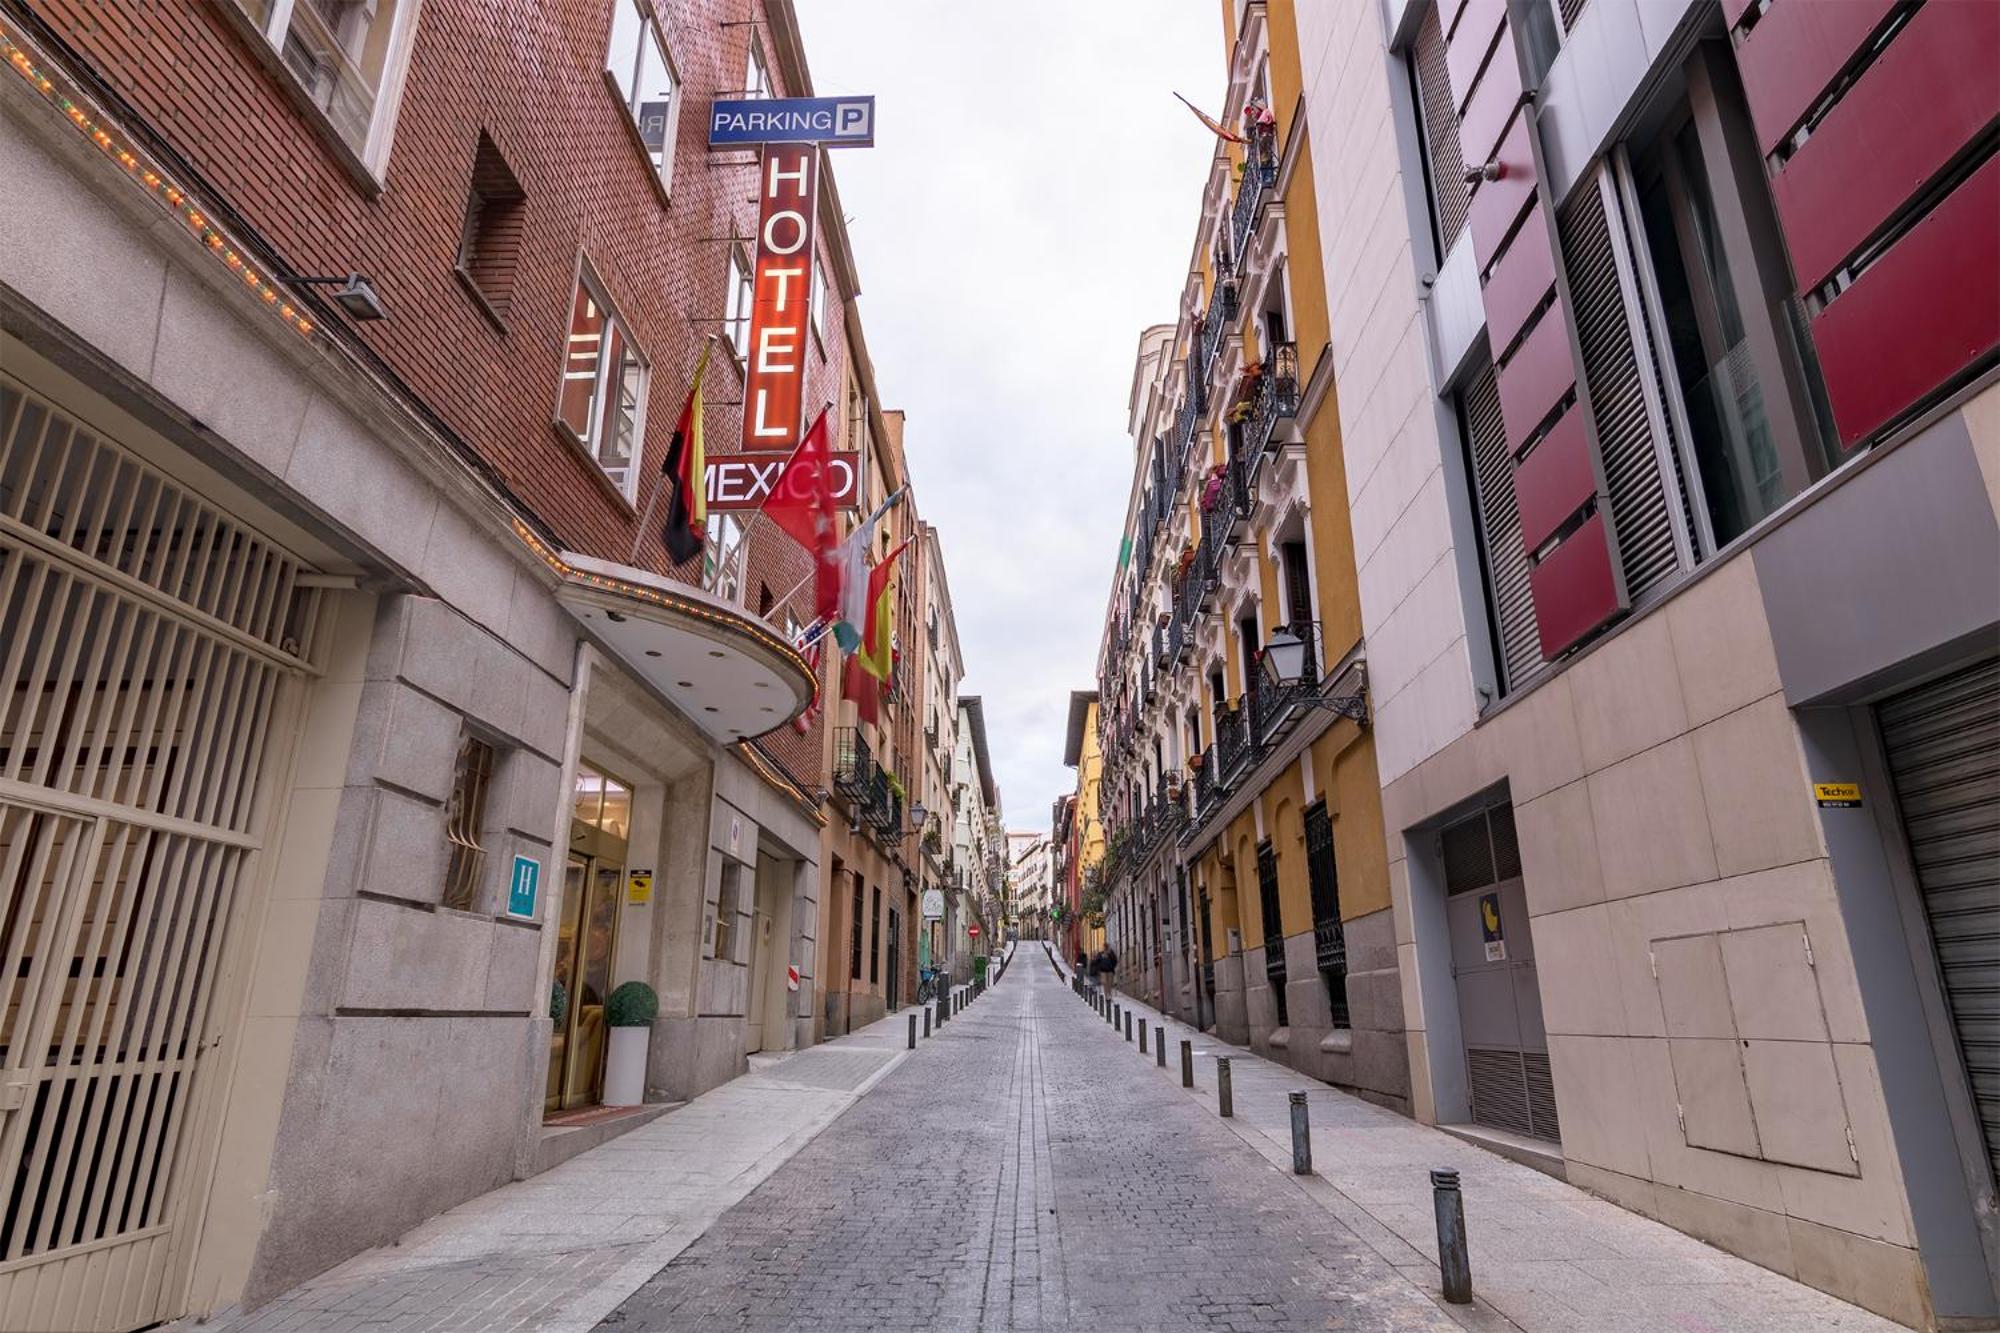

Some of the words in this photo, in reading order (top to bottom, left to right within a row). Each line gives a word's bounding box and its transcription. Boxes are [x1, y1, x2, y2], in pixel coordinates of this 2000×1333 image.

[713, 110, 832, 132] PARKING
[841, 108, 864, 131] P
[754, 155, 809, 437] HOTEL
[517, 864, 533, 896] H
